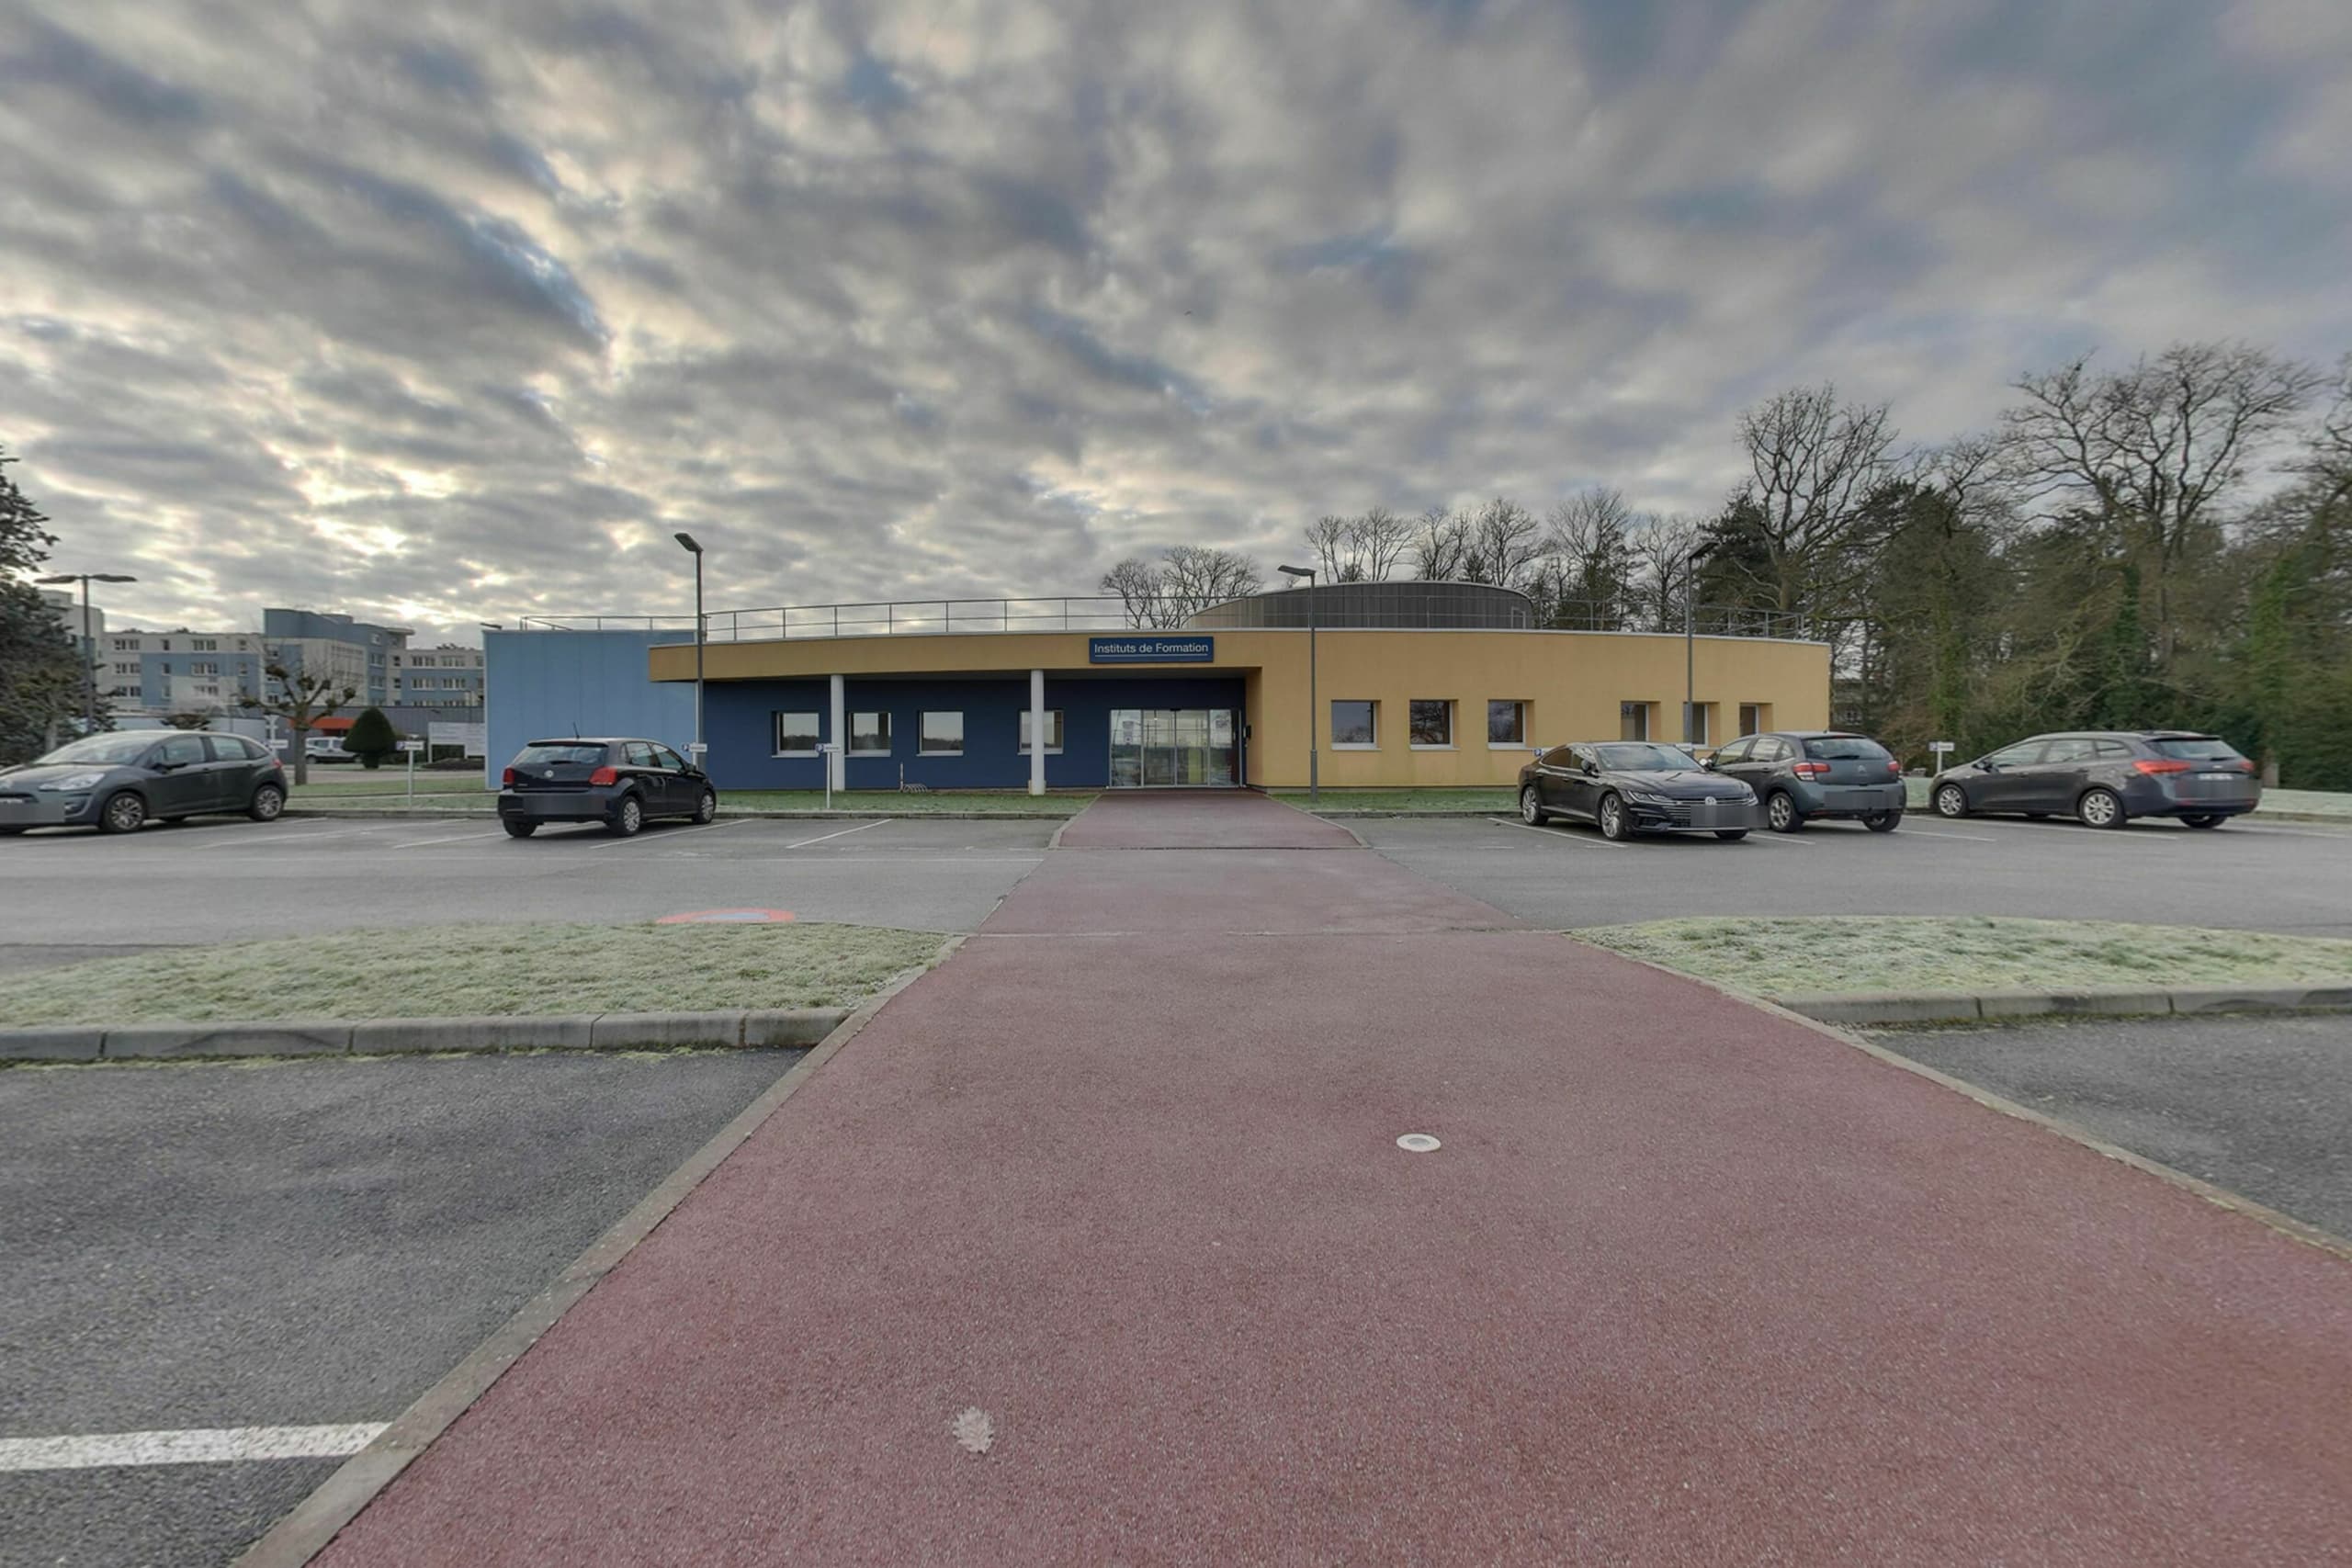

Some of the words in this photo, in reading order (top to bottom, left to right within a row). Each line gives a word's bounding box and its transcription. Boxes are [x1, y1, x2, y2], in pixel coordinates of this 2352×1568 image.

[1094, 643, 1136, 654] Instituts
[1138, 643, 1153, 653] de
[1155, 642, 1209, 653] Formation
